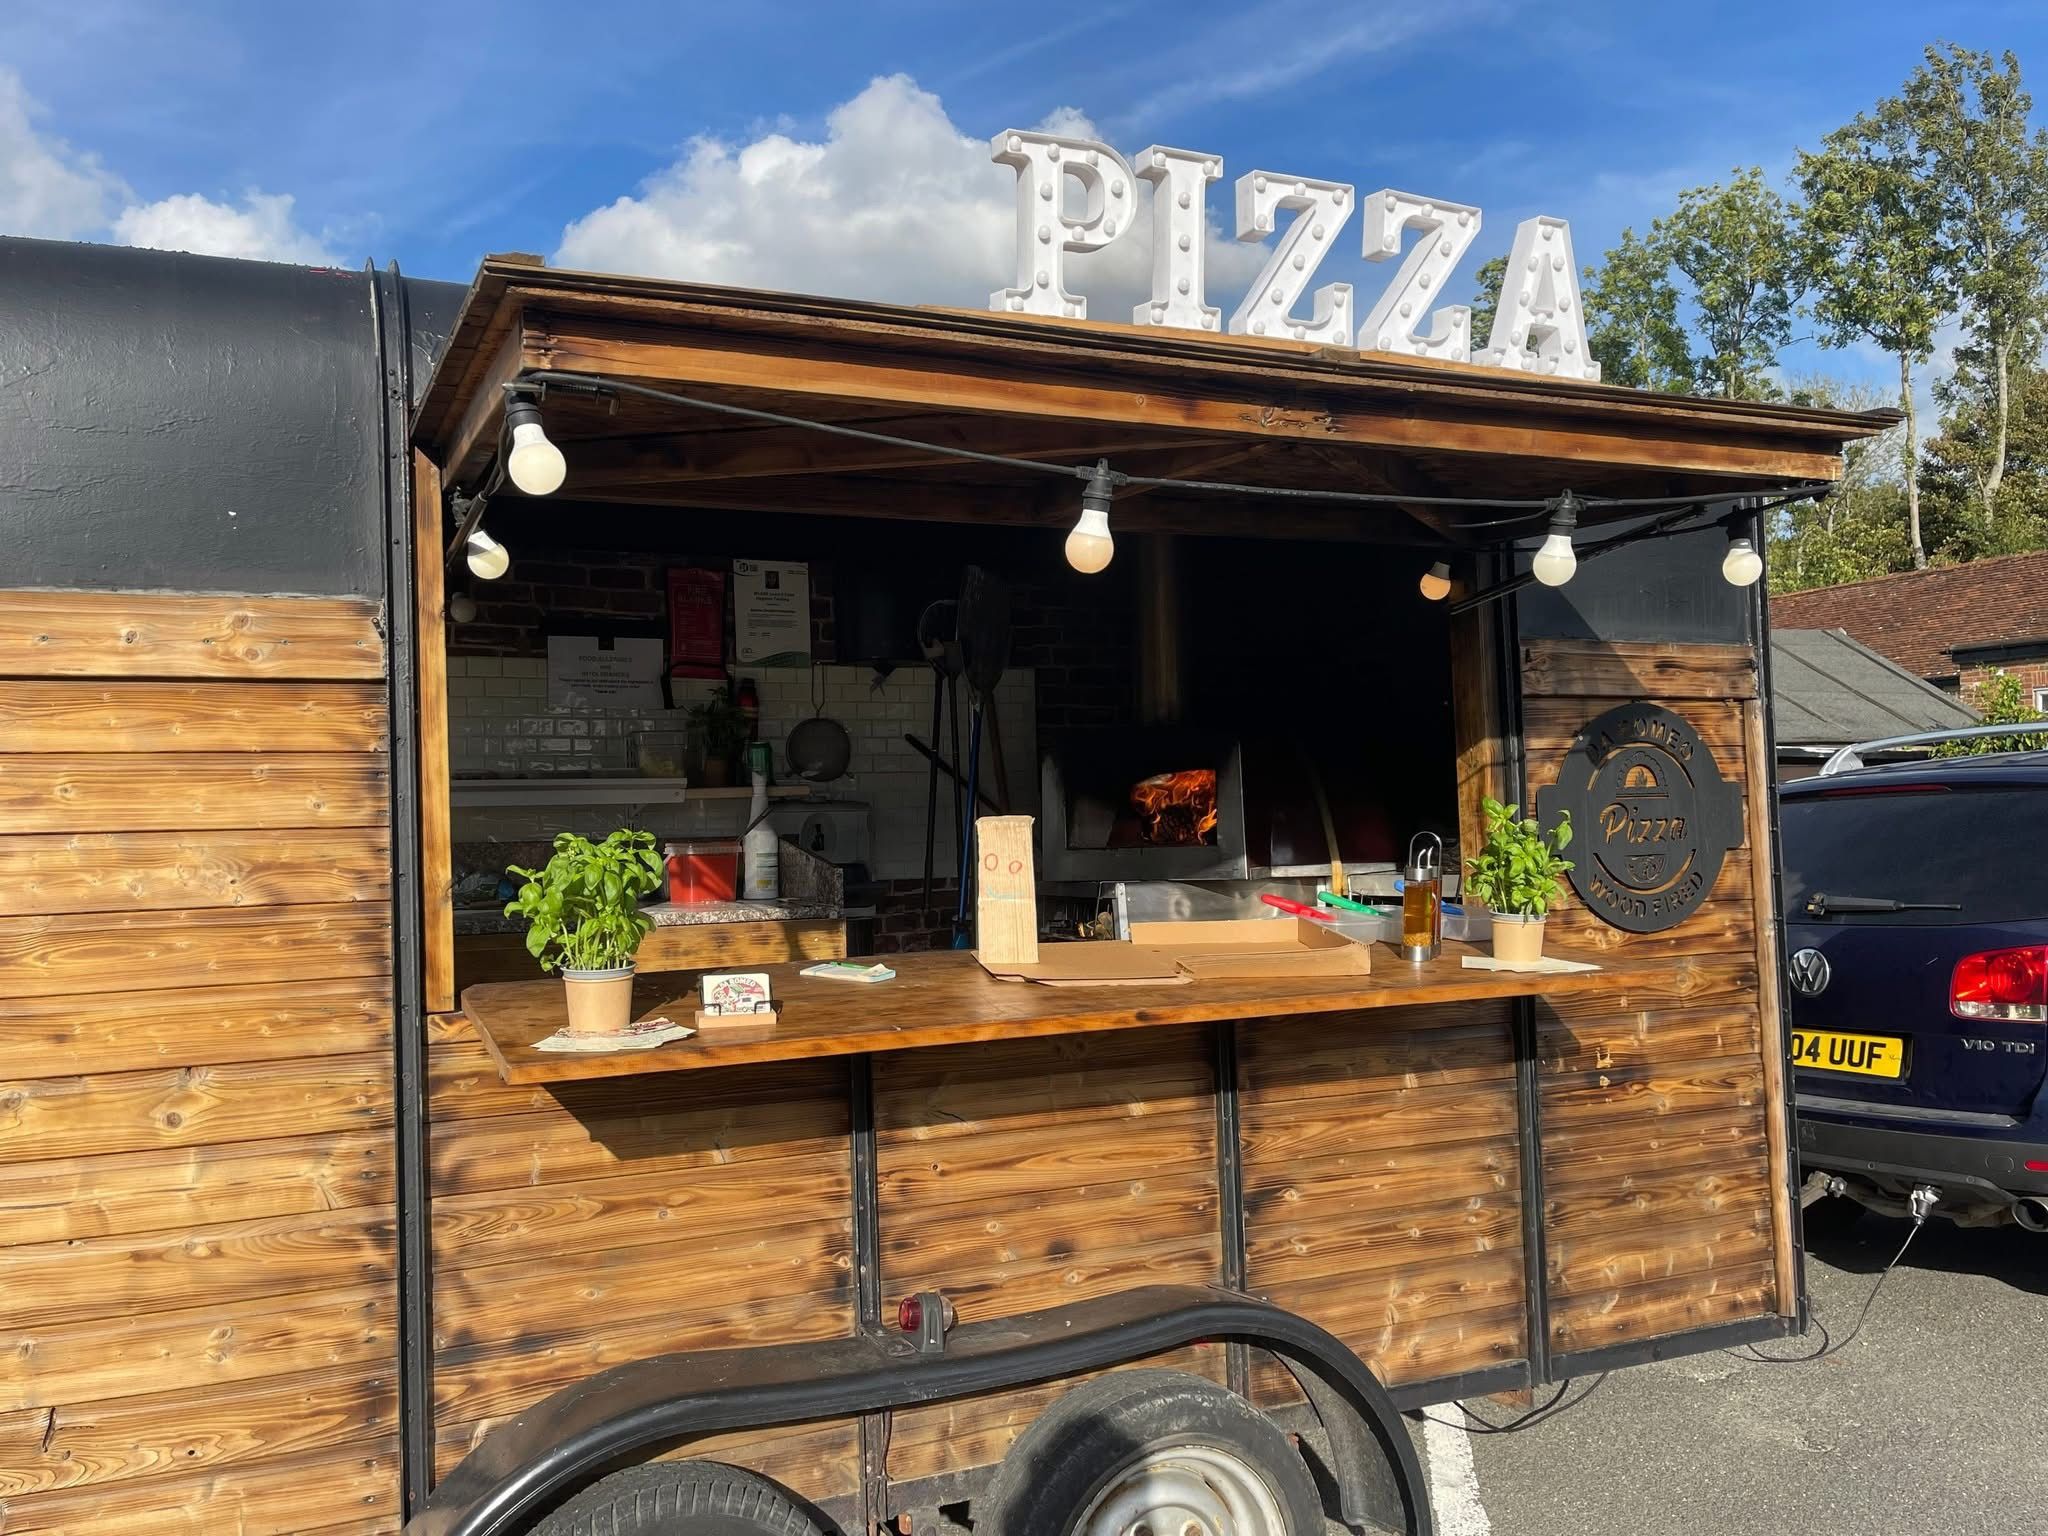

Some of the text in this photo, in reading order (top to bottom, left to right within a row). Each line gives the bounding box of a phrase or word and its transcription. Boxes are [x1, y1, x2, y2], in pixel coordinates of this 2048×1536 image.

[990, 128, 1601, 381] PIZZA
[1600, 802, 1688, 844] Pizza
[1590, 871, 1704, 918] WOOD FIRED
[1829, 1037, 1886, 1069] UUF
[1961, 1038, 2035, 1054] V10 TDI
